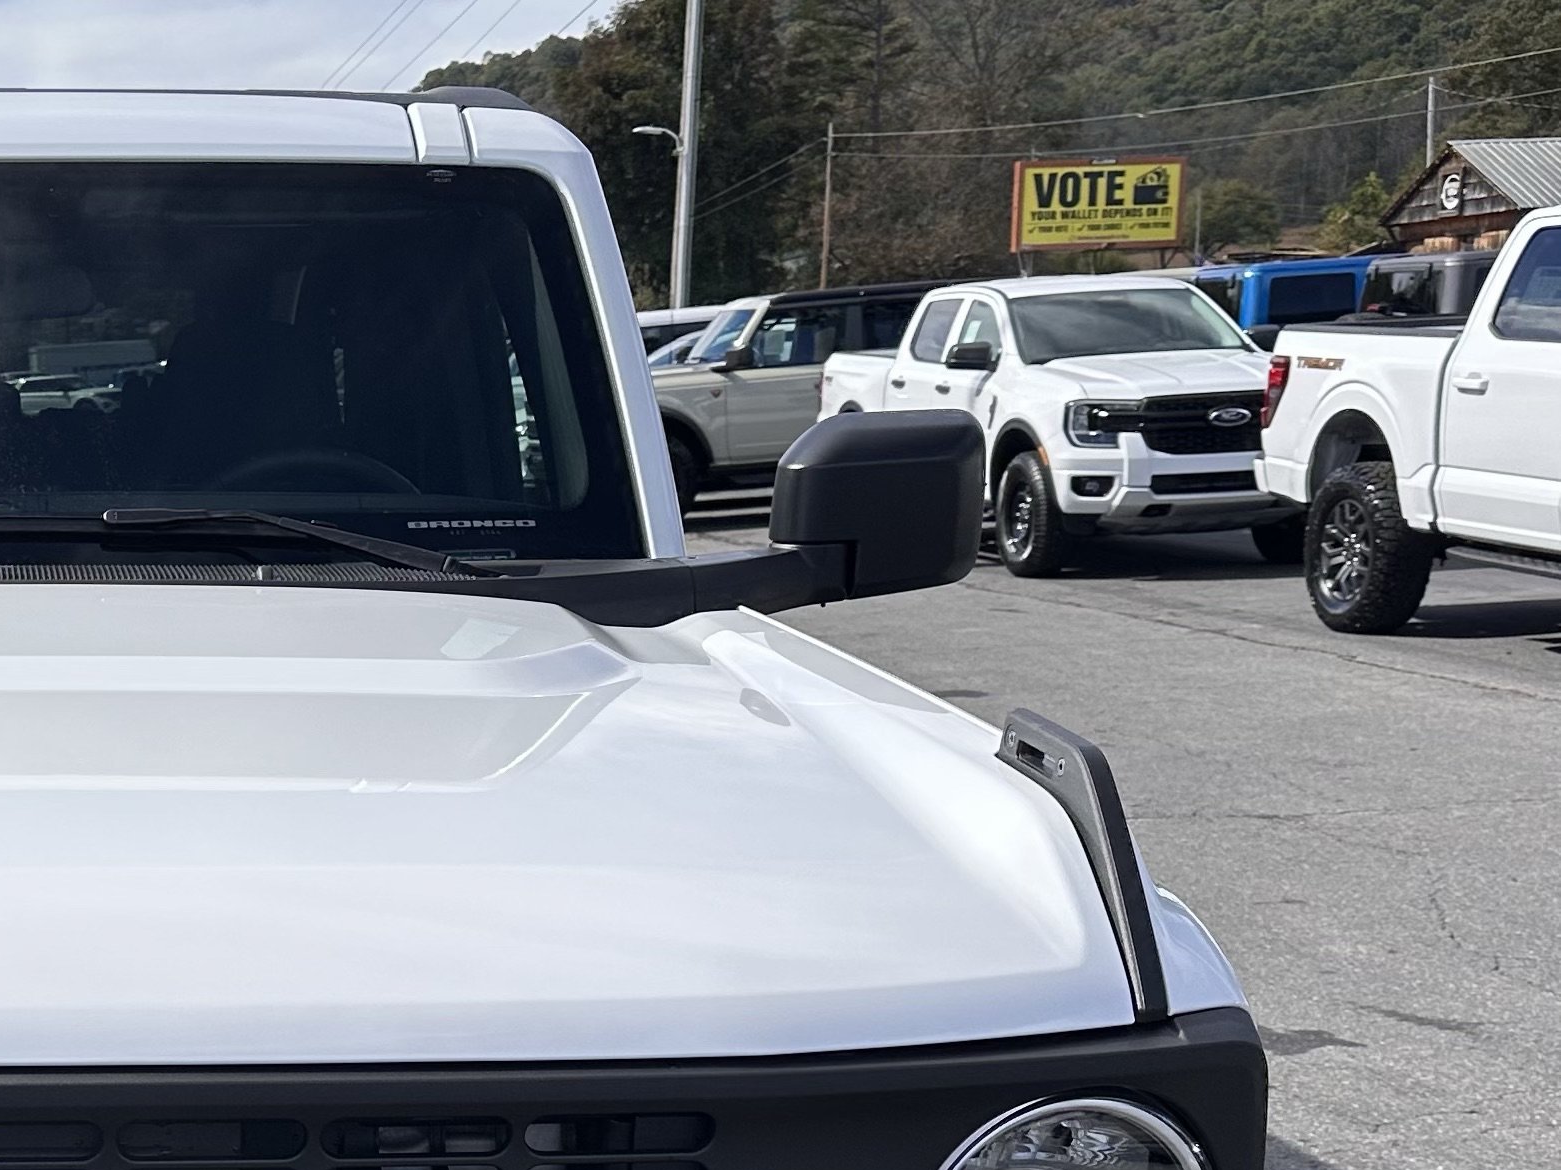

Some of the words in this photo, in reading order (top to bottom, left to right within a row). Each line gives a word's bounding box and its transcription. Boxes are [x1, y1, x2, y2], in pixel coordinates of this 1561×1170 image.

[1033, 171, 1126, 208] VOTE
[1031, 210, 1057, 221] YOUR
[1061, 209, 1099, 220] WALLET
[1102, 207, 1143, 219] DEPENDS
[1146, 207, 1158, 217] ON
[407, 519, 536, 529] BRONCO
